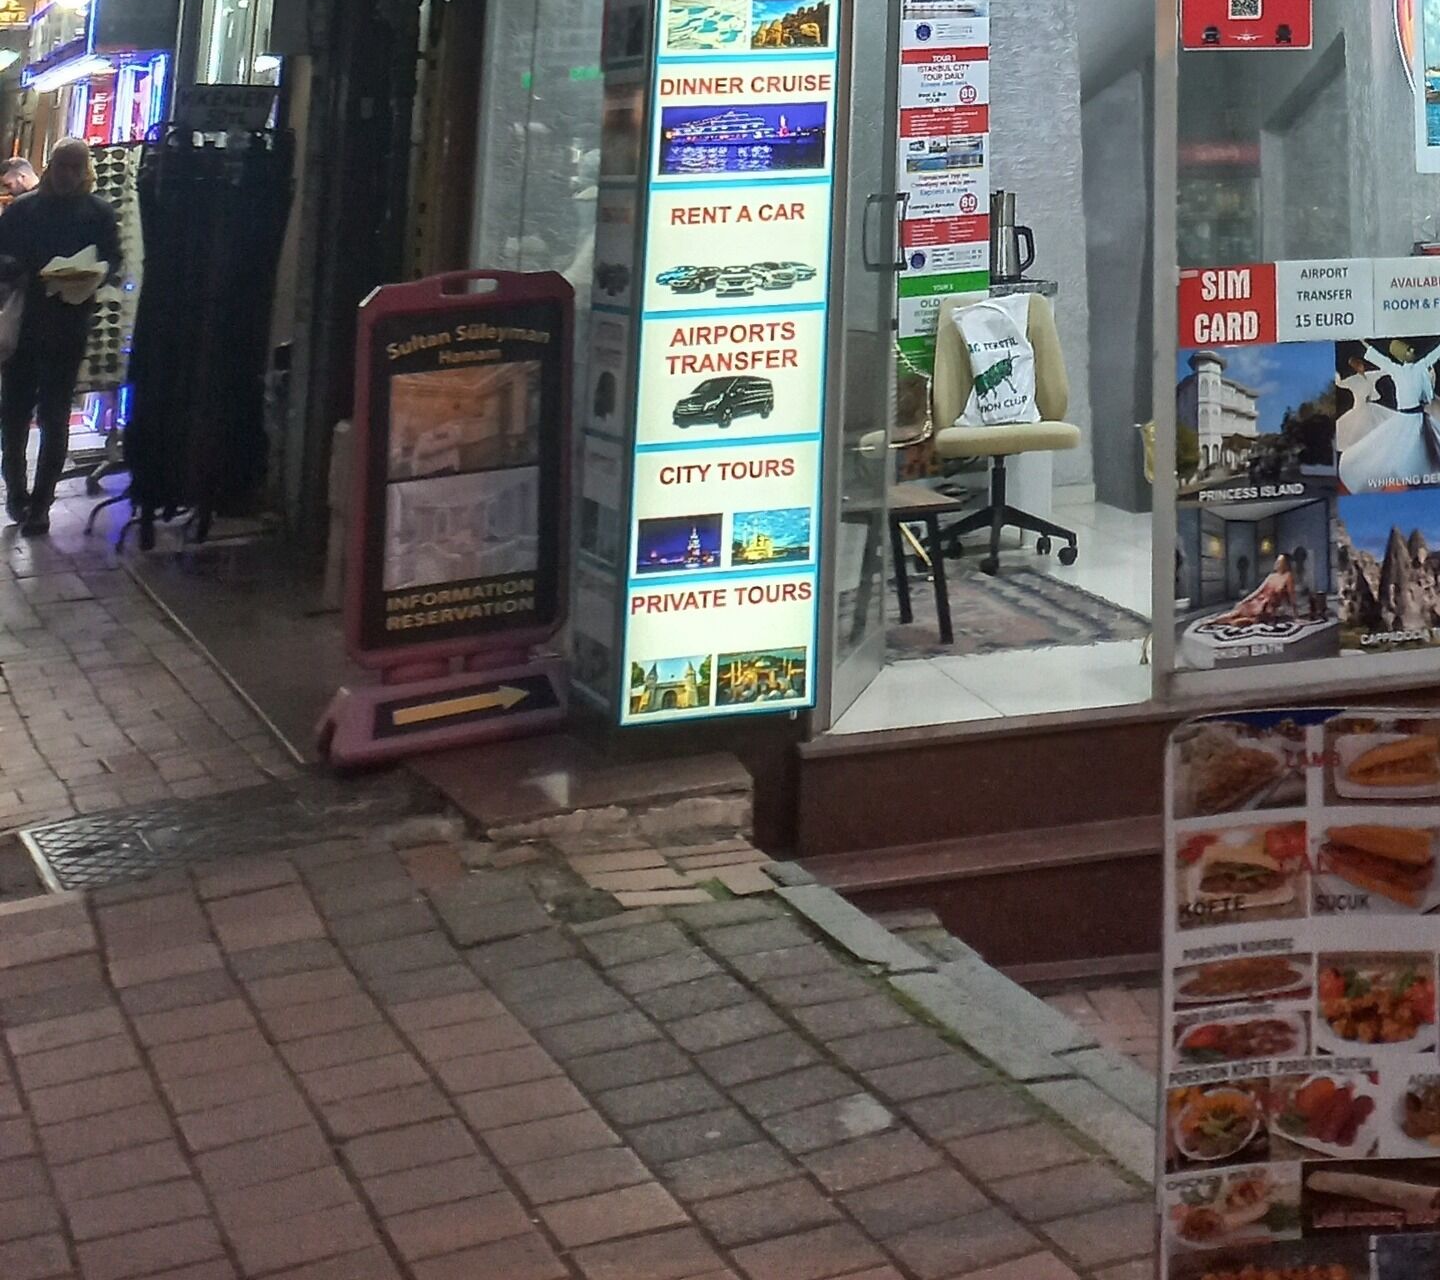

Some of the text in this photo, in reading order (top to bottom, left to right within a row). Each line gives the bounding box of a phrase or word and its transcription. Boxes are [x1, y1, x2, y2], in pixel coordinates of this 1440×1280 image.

[660, 74, 832, 96] DINNER CRUISE
[670, 202, 806, 226] RENT A CAR
[1201, 268, 1251, 302] SIM
[1300, 267, 1349, 280] AIRPORT
[920, 298, 941, 309] OLD
[1296, 289, 1353, 302] TRANSFER
[1382, 297, 1420, 312] ROOM
[1421, 297, 1432, 310] &
[1194, 310, 1260, 344] CARD
[1295, 312, 1355, 329] 15 EURO
[386, 329, 452, 361] Sultan
[669, 321, 796, 348] AIRPORTS
[665, 348, 799, 376] TRANSFER
[658, 457, 796, 486] CITY TOURS
[1367, 476, 1421, 490] WHIRLING
[1198, 482, 1305, 503] PRINCESS ISLAND
[385, 578, 535, 615] INFORMATION
[630, 581, 813, 616] PRIVATE TOURS
[385, 597, 535, 632] RESERVATION
[1250, 642, 1285, 657] BATH
